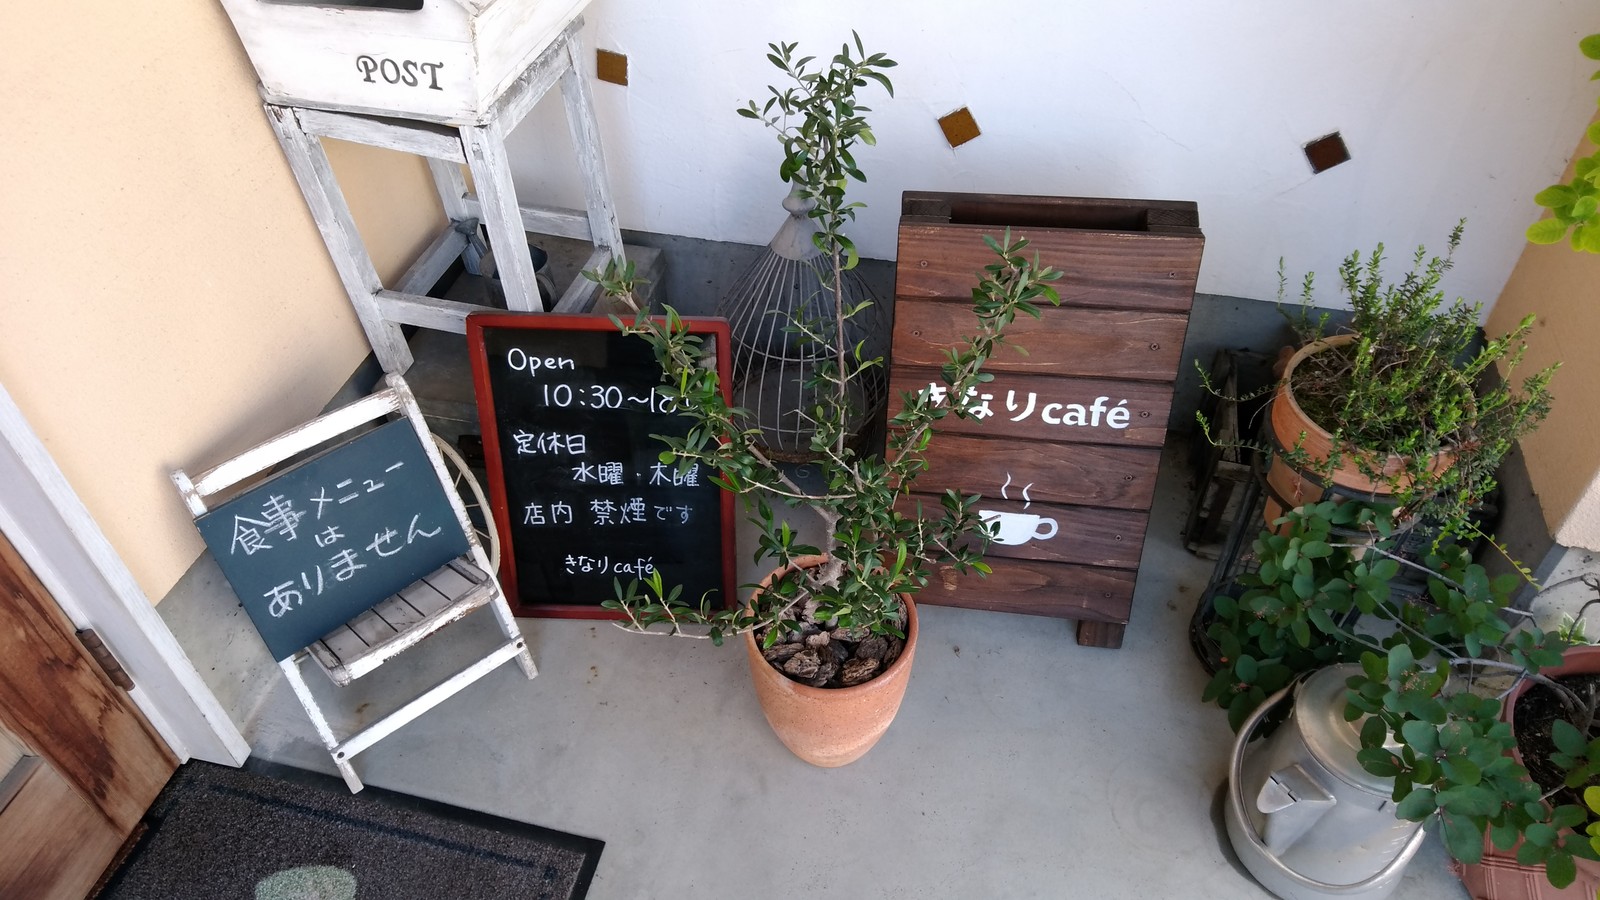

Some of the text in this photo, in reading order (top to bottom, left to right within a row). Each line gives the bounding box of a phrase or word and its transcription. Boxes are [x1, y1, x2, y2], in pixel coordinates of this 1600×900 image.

[356, 55, 444, 91] POST
[507, 347, 575, 378] Open
[512, 429, 586, 455] 定休日
[314, 525, 346, 548] は
[262, 512, 442, 619] ありません
